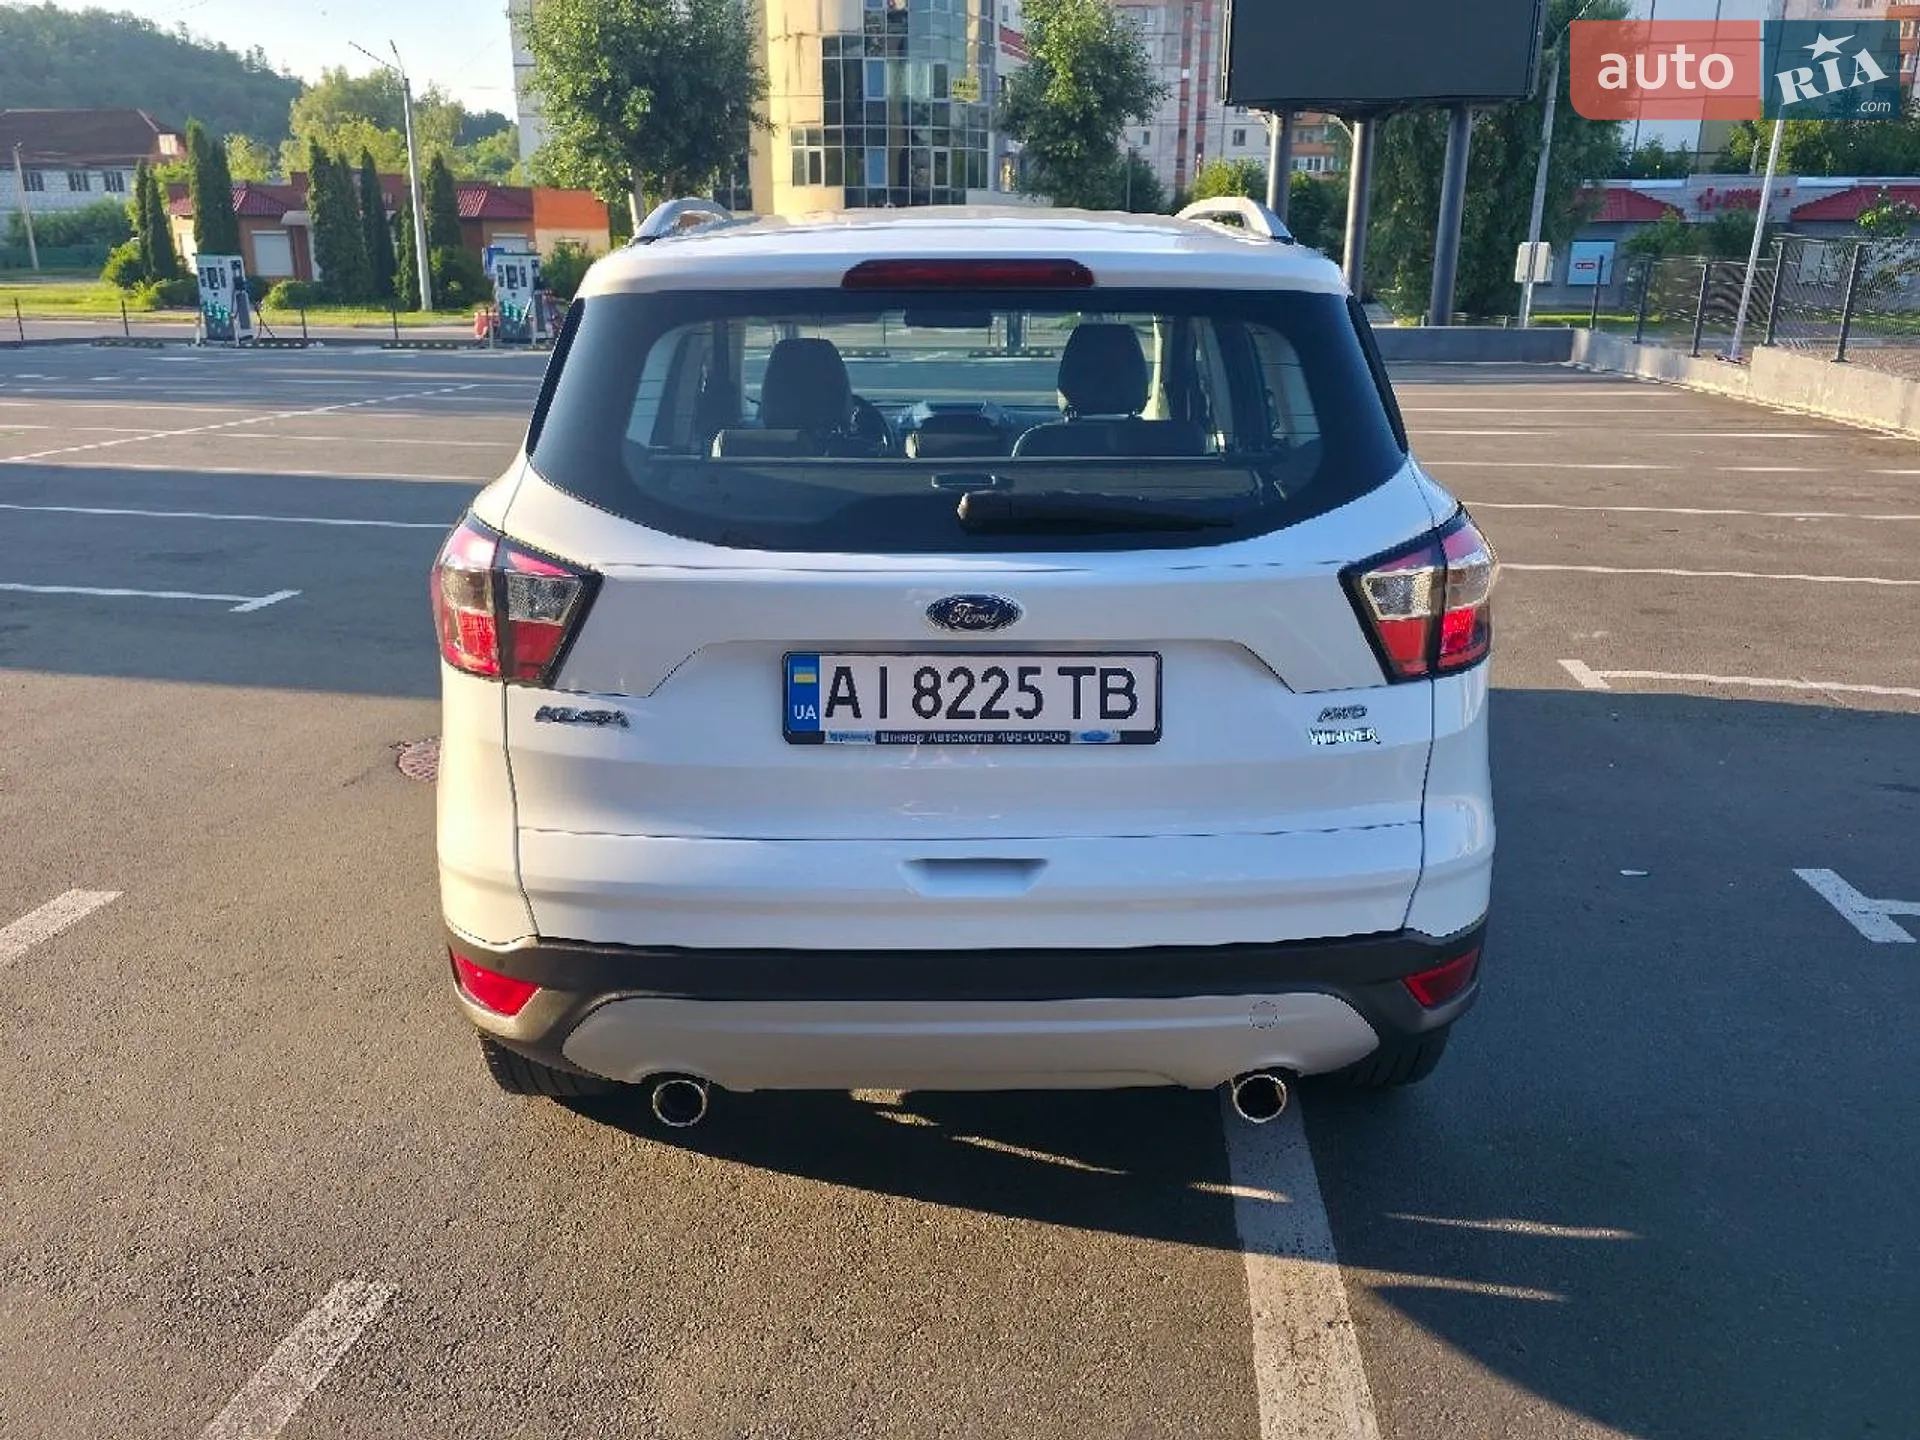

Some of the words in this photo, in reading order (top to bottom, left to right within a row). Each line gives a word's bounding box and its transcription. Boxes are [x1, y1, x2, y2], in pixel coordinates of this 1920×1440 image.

[948, 602, 1000, 624] Ford
[911, 665, 1044, 720] 8225
[1057, 665, 1139, 720] TB
[794, 705, 817, 720] UA
